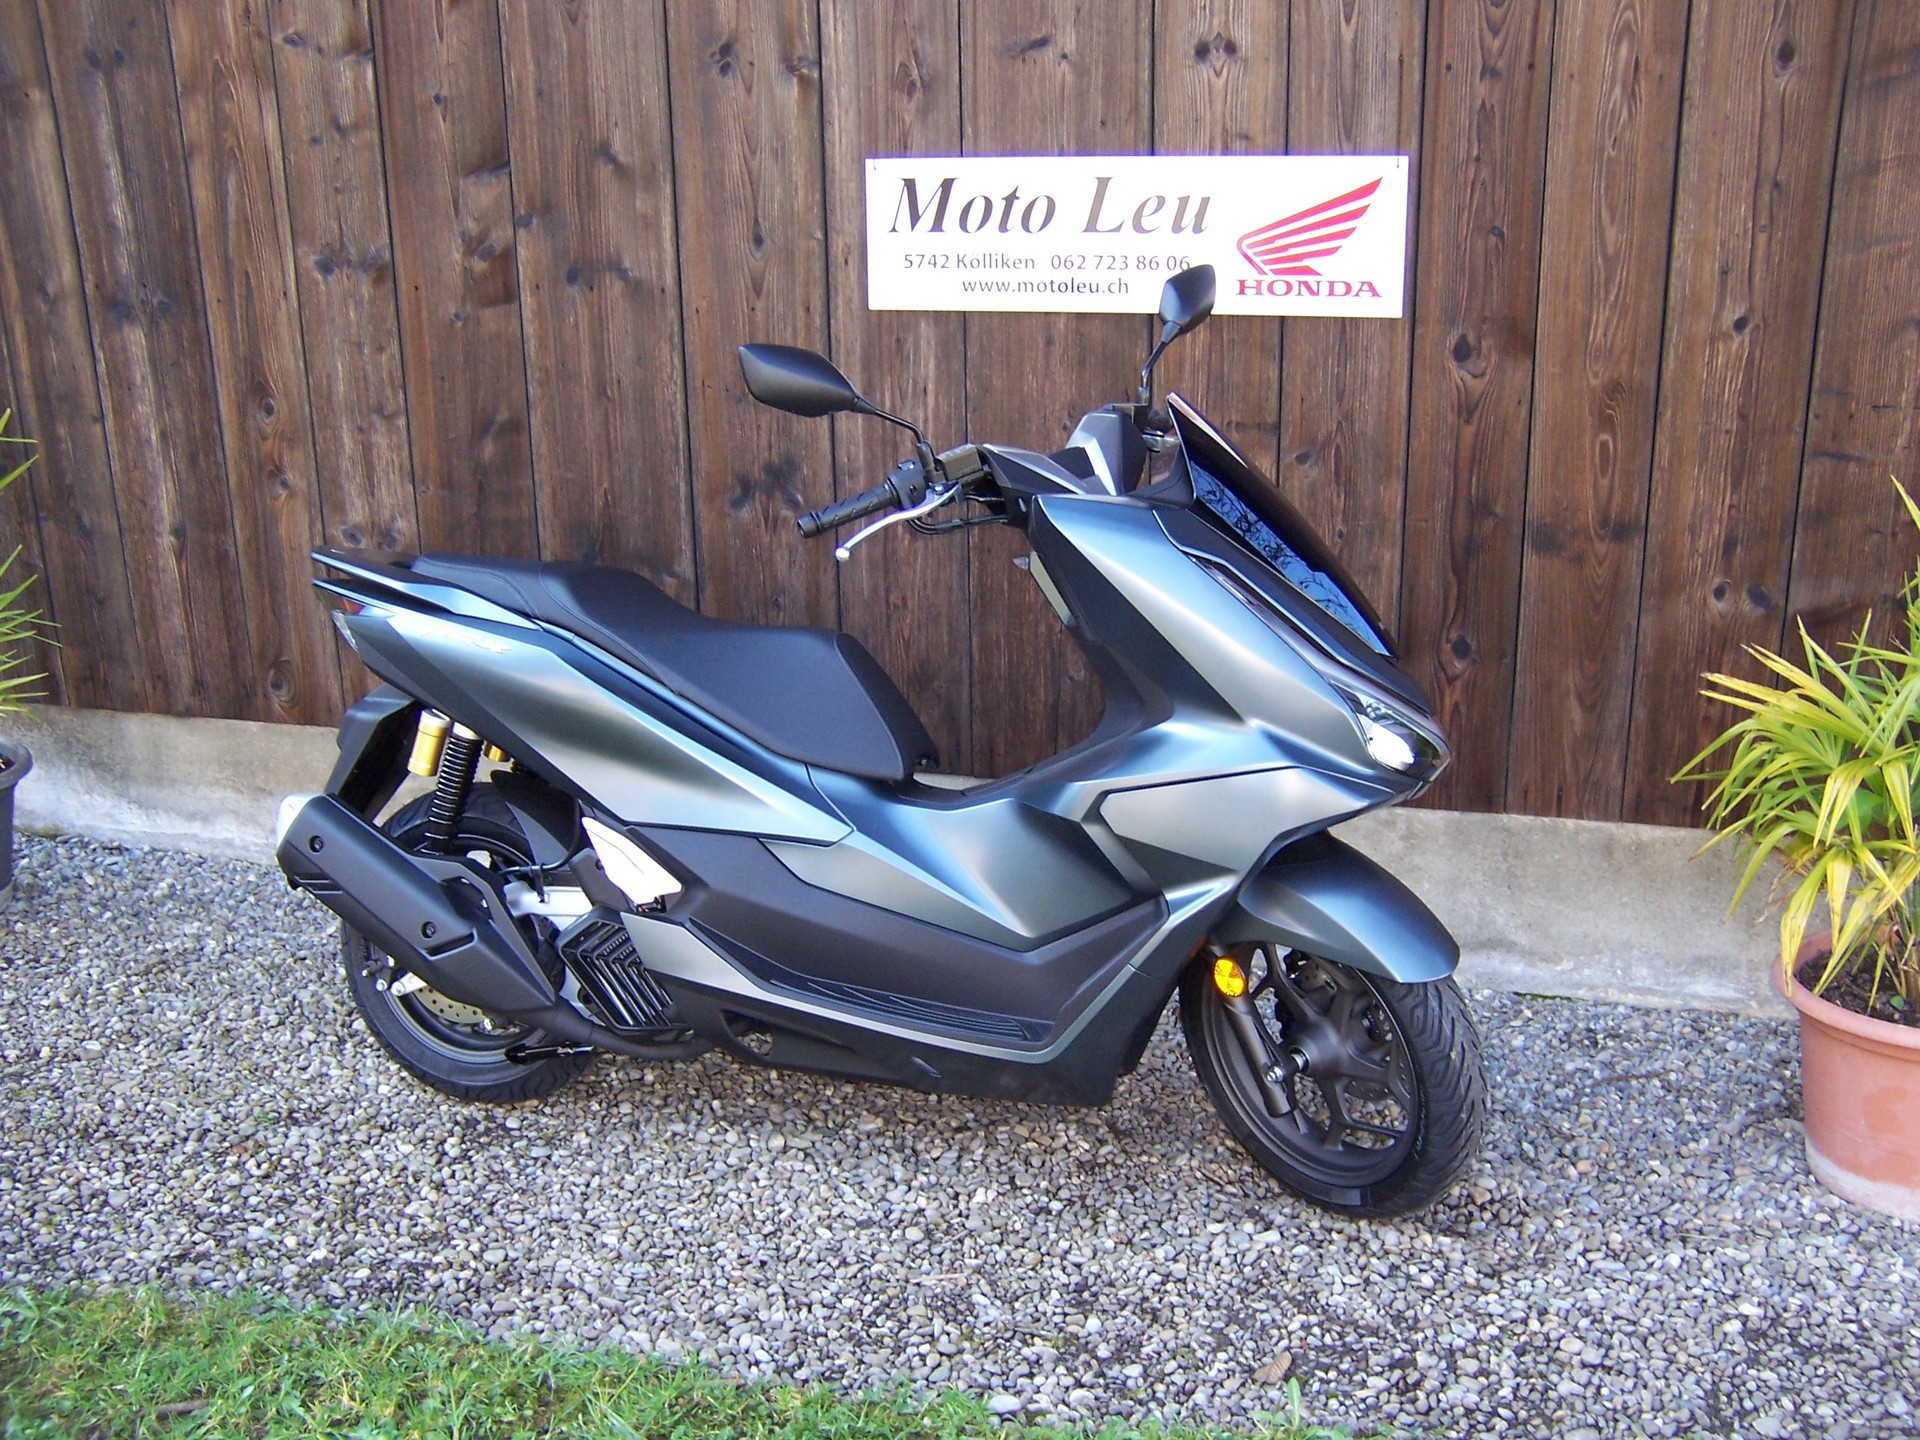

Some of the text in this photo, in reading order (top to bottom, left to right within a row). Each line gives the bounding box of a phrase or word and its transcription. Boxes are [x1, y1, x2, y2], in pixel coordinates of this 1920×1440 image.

[886, 176, 1211, 234] Moto Leu
[903, 253, 950, 269] 5742
[1051, 254, 1087, 270] 062
[1093, 254, 1129, 271] 723
[1136, 255, 1160, 271] 86
[1166, 255, 1191, 272] 06
[962, 277, 1129, 294] www.motoleu.ch
[1235, 278, 1383, 298] HONDA
